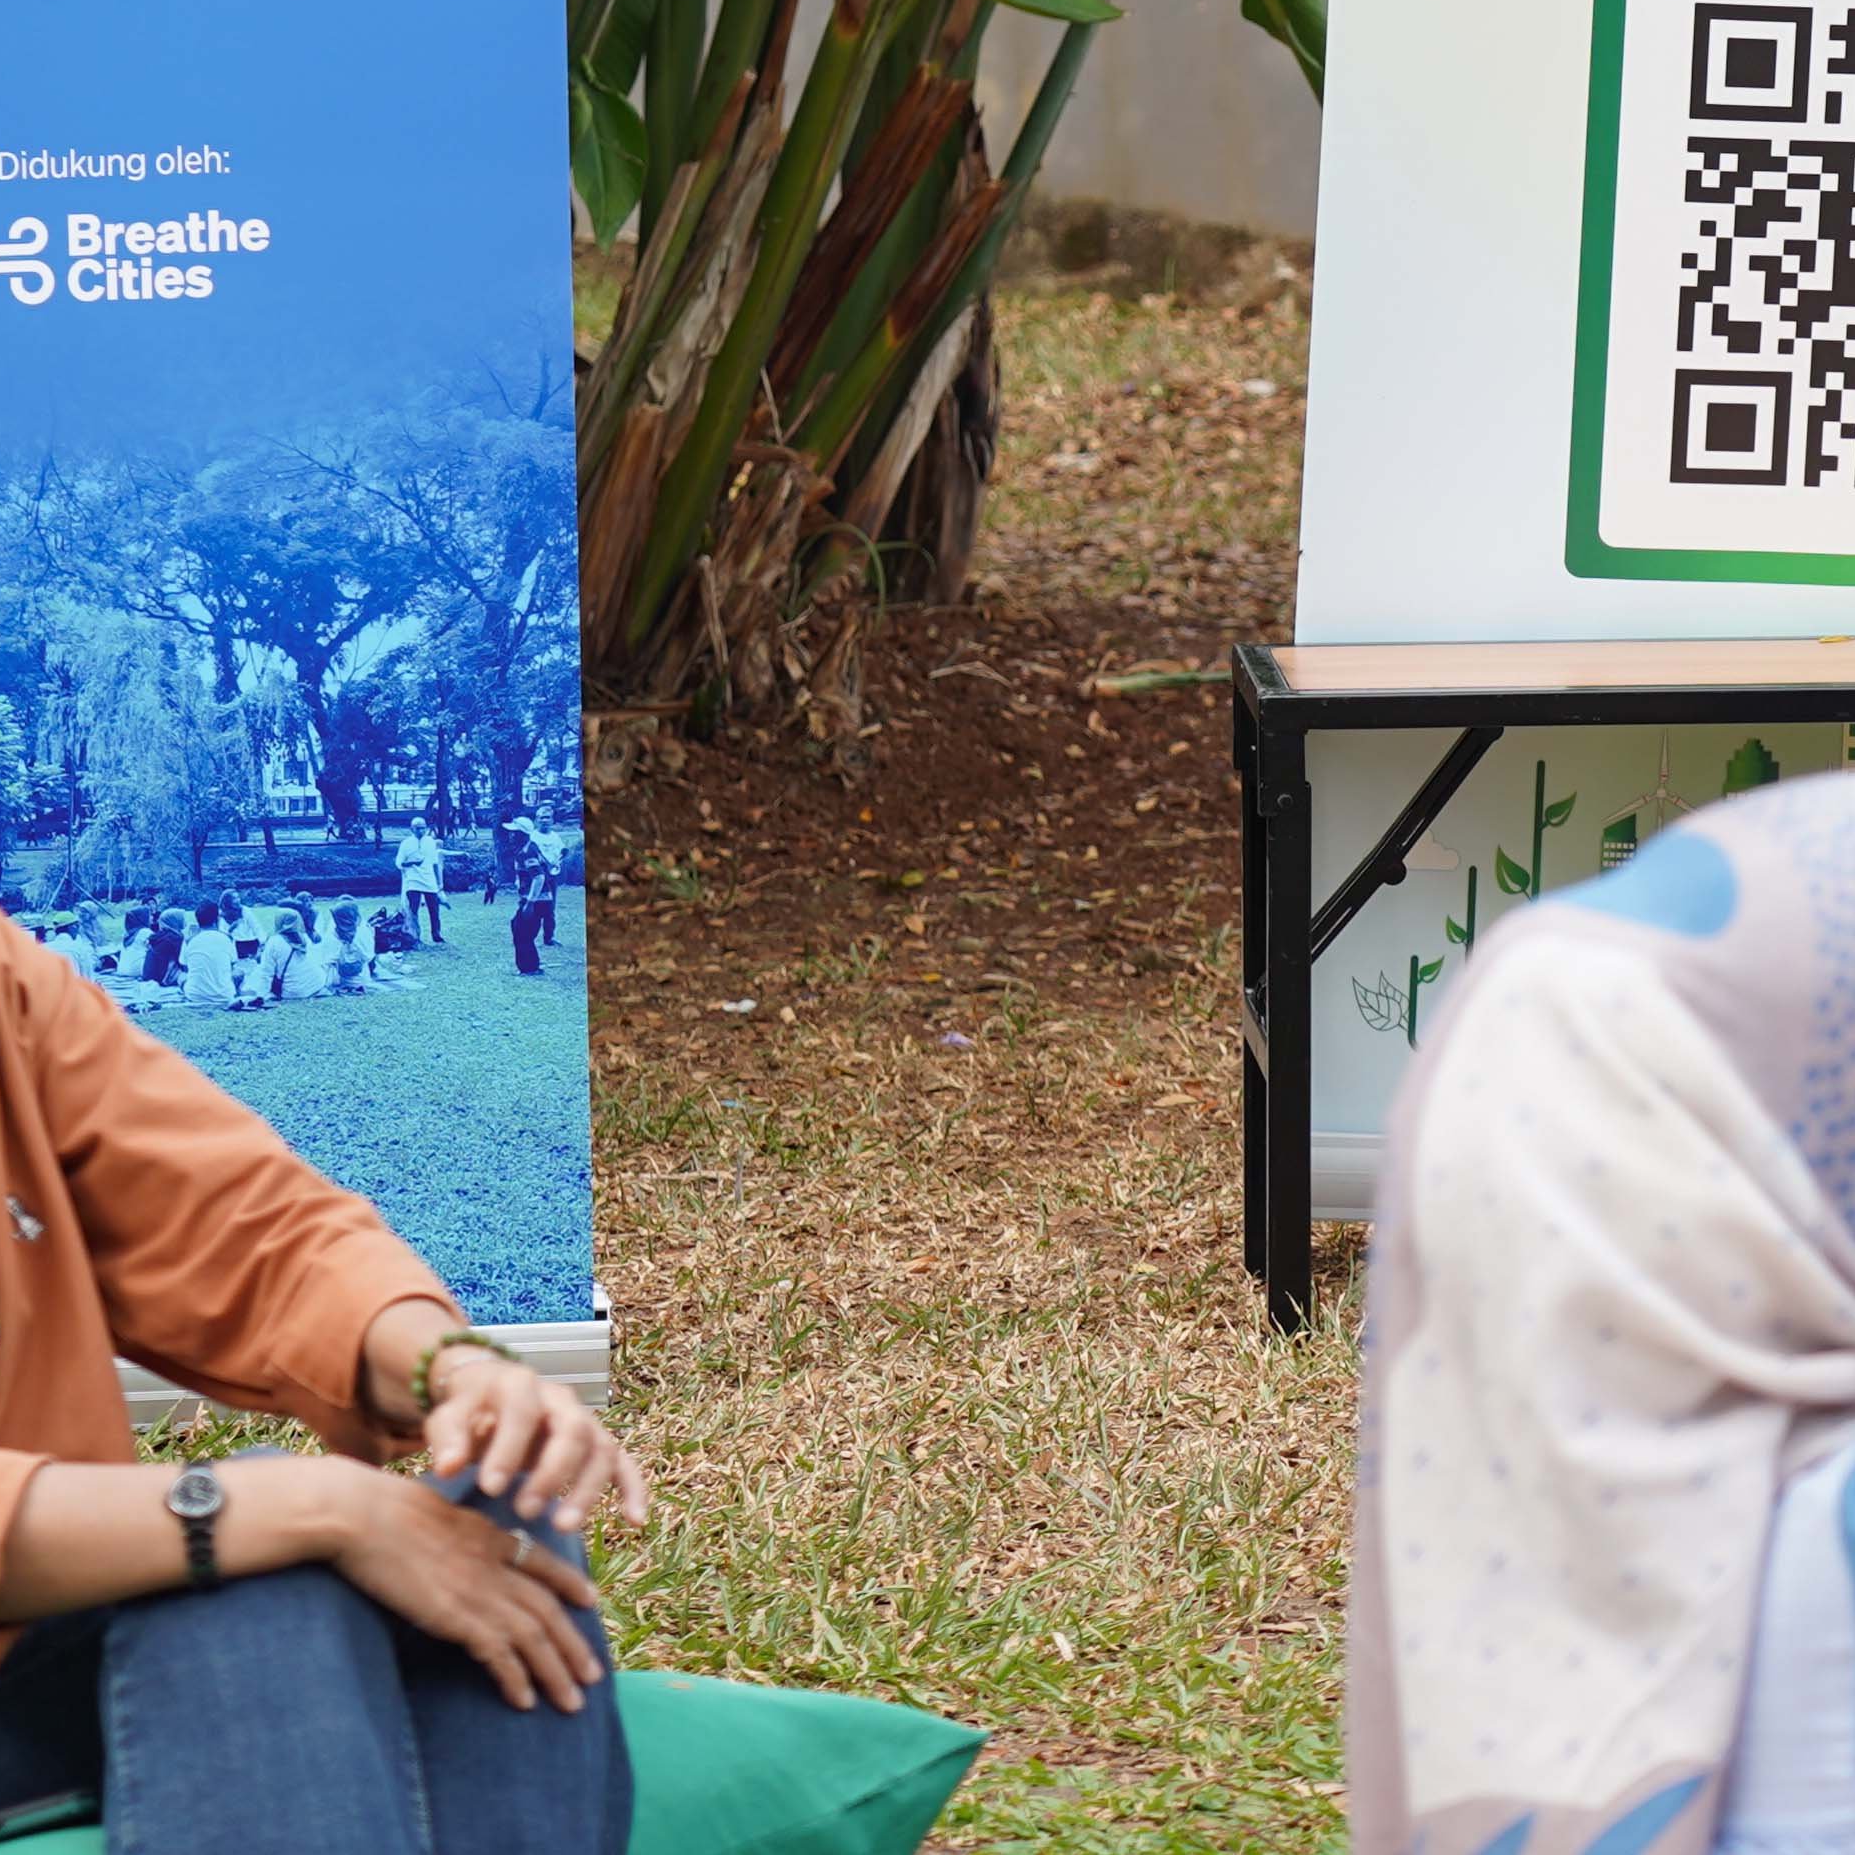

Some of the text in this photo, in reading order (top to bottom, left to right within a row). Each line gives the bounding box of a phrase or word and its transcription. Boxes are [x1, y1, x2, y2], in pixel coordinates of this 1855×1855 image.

[155, 144, 231, 176] oleh:
[67, 209, 271, 255] Breathe
[67, 257, 214, 302] Cities
